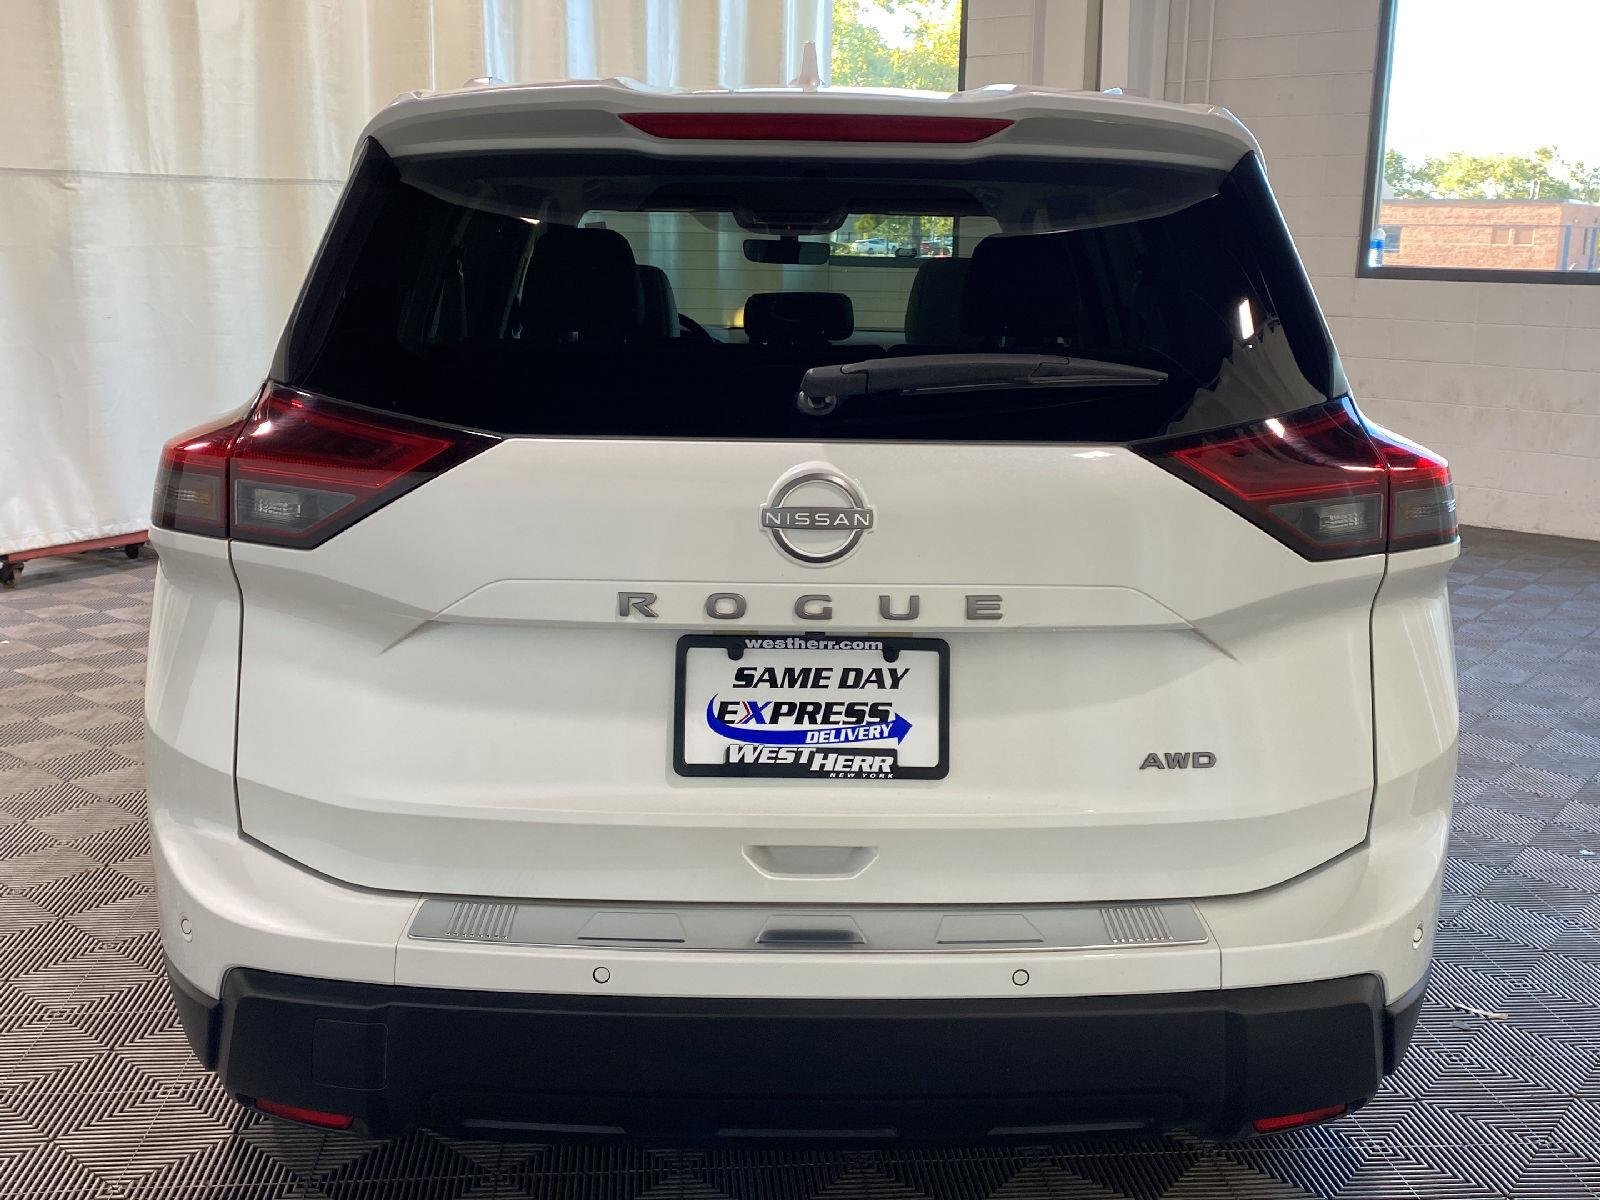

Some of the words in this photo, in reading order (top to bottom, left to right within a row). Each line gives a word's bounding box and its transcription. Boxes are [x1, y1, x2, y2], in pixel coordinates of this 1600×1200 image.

[765, 511, 870, 527] NISSAN
[617, 591, 1003, 621] ROGUE
[744, 637, 883, 650] westherr.com
[732, 666, 834, 689] SAME
[838, 667, 911, 690] DAY
[716, 701, 893, 725] EXPRESS
[805, 722, 895, 745] DELIVERY
[1139, 751, 1217, 769] AWD
